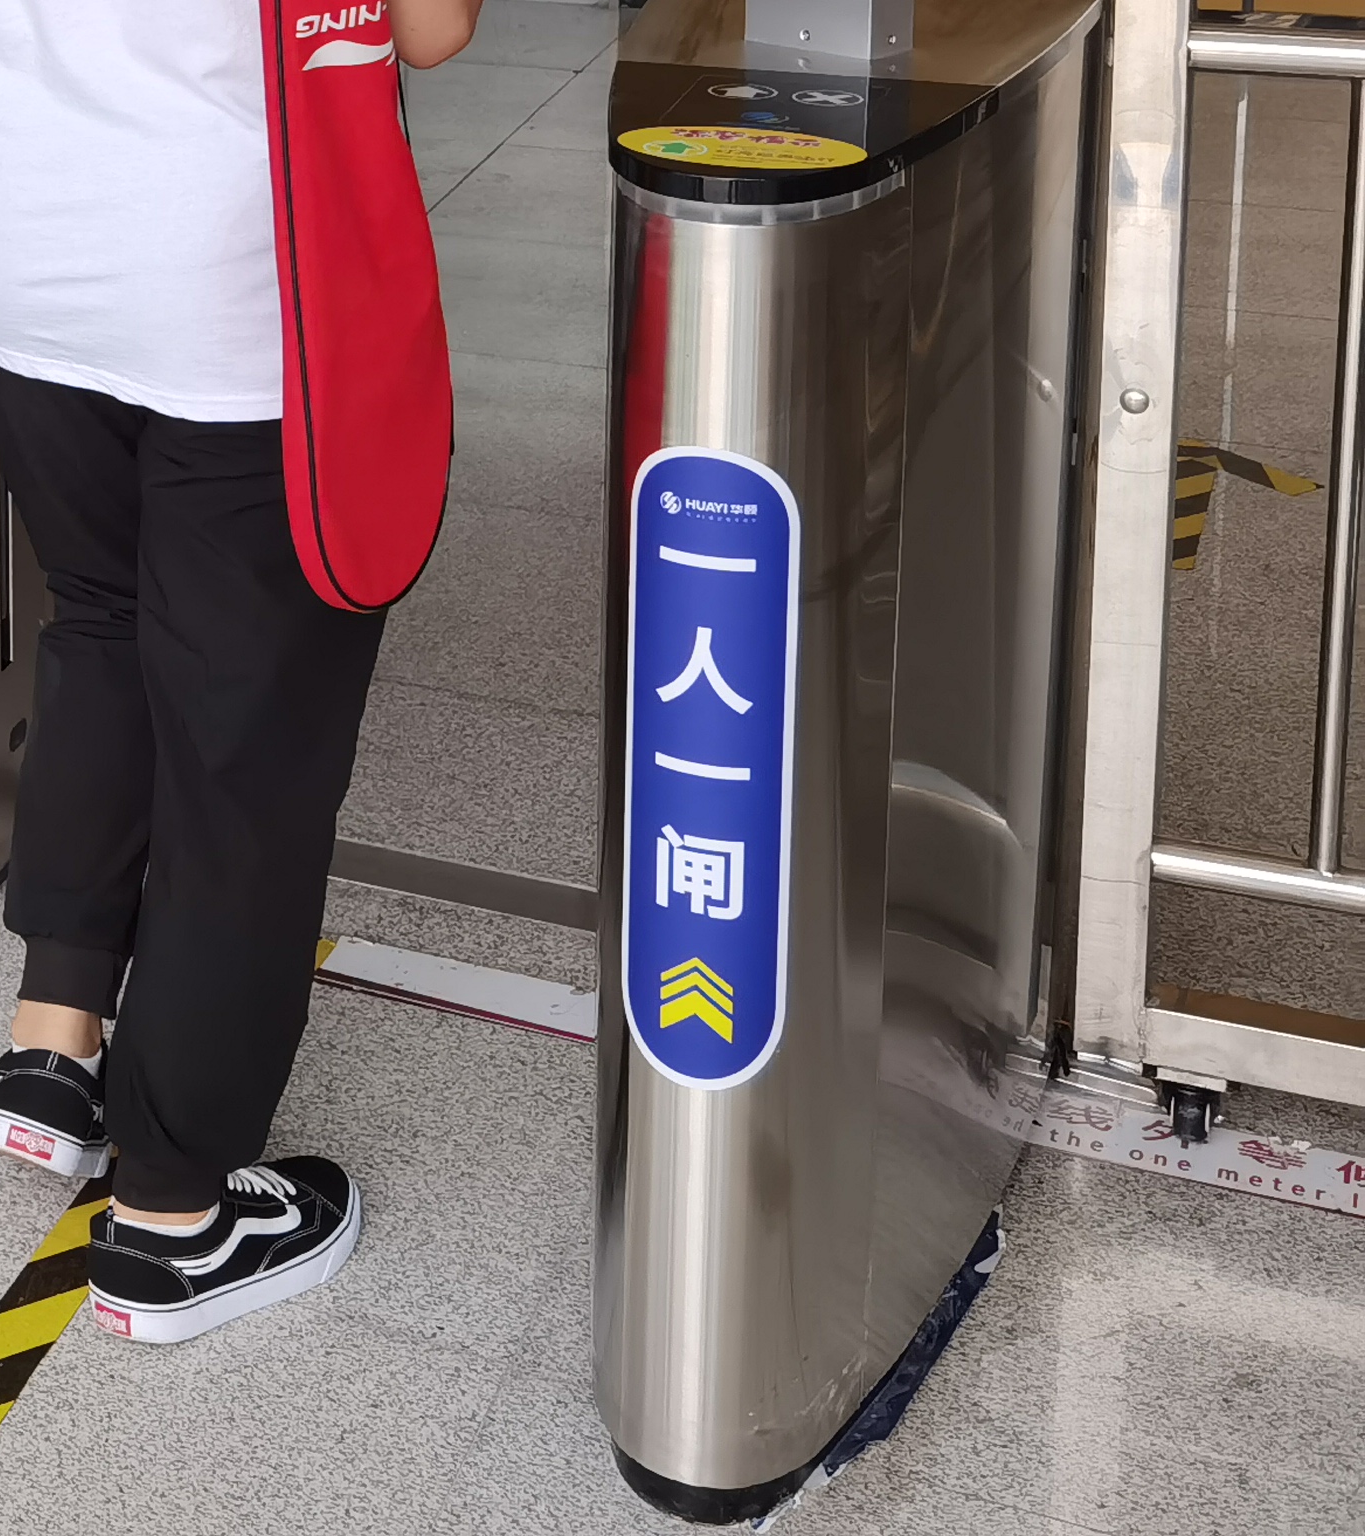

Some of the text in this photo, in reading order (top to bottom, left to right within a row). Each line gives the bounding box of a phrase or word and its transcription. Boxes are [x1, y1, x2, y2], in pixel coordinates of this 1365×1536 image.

[685, 498, 728, 515] HUAYI
[655, 545, 757, 922] 一人一闸
[1049, 1128, 1105, 1153] the
[1129, 1147, 1192, 1172] one
[1217, 1167, 1327, 1201] meter
